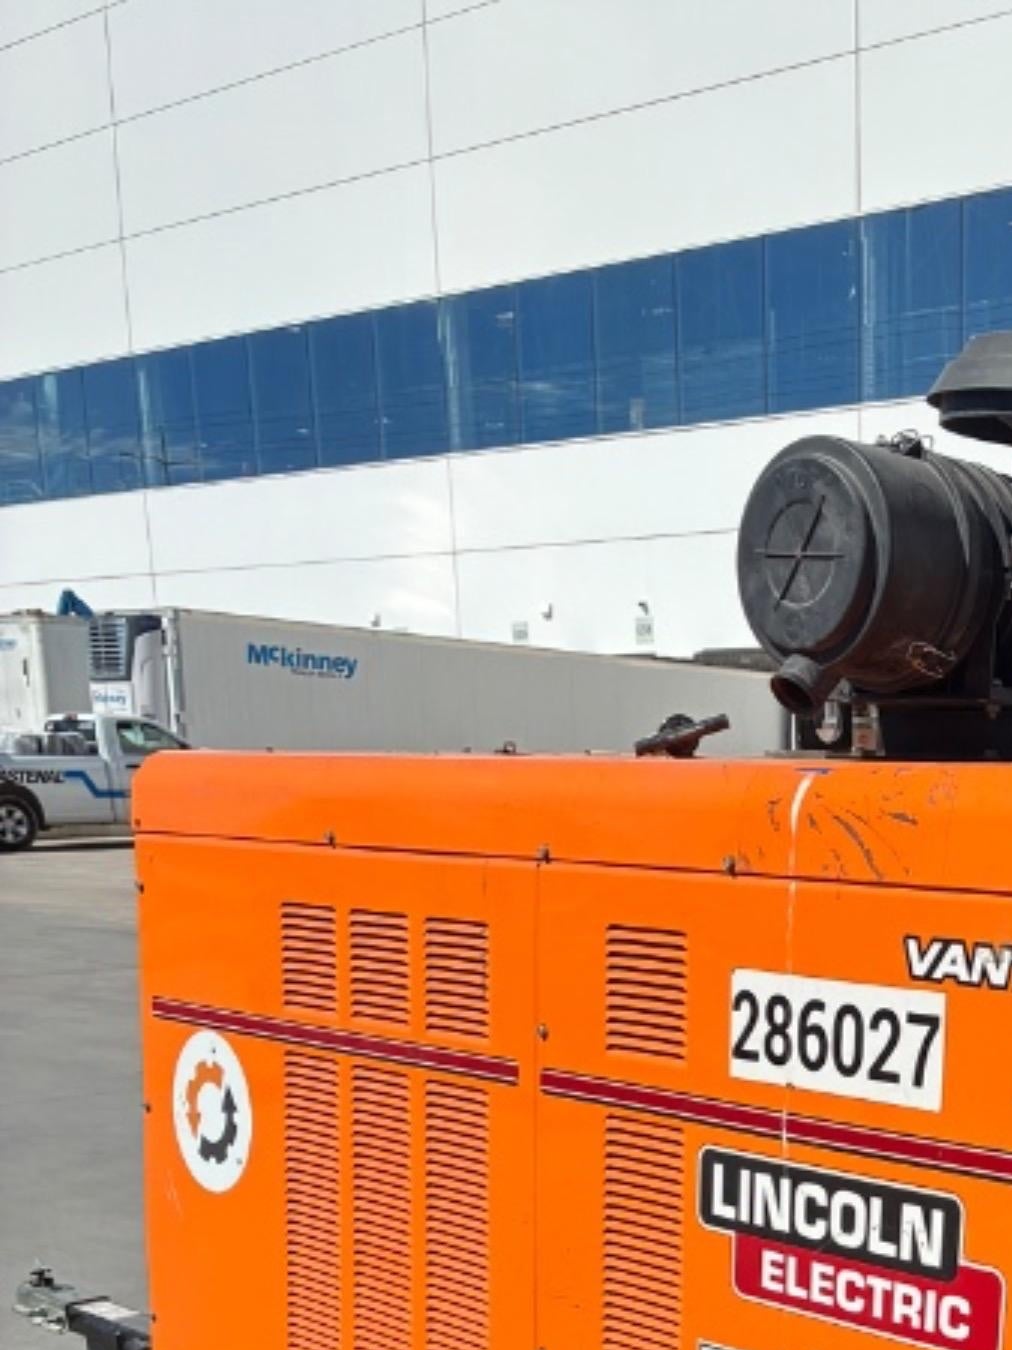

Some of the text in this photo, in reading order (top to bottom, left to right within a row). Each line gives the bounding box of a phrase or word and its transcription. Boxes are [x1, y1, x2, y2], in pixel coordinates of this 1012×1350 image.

[0, 768, 65, 785] ASTENAL
[731, 989, 941, 1089] 286027
[711, 1161, 947, 1270] LINCOLN
[760, 1250, 971, 1342] ELECTRIC
